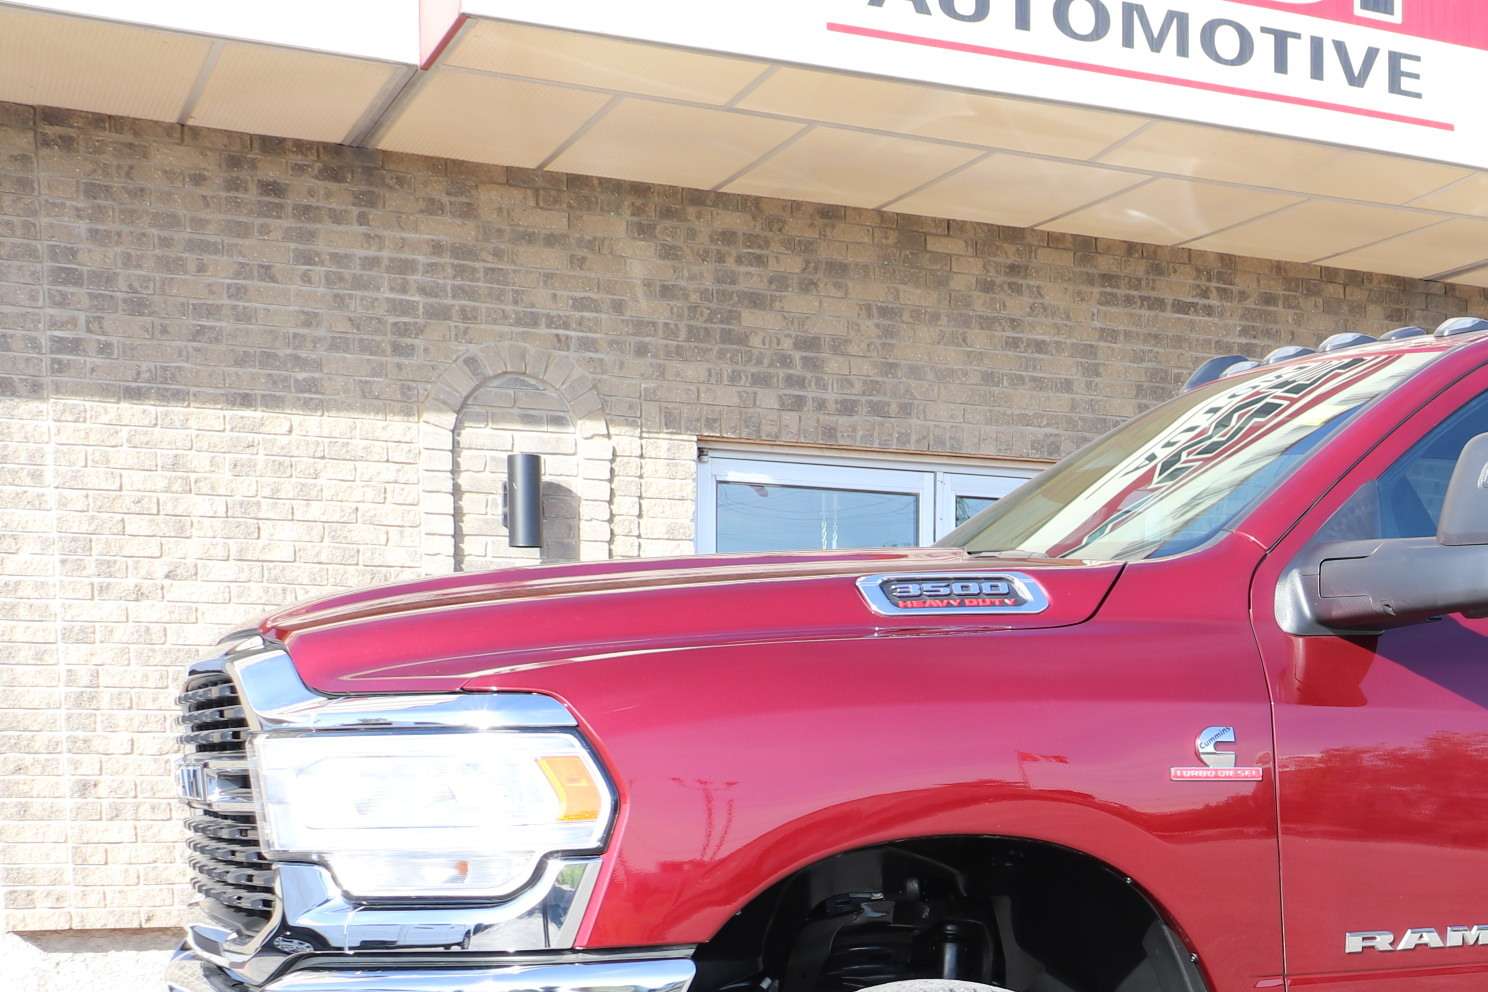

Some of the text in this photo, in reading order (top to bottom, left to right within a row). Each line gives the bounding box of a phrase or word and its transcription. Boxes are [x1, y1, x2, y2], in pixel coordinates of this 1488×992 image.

[866, 0, 1423, 100] TOMOTIVE
[891, 582, 1010, 598] 3500
[897, 598, 1017, 609] HEAVY DUTY
[1199, 727, 1232, 750] Cummins
